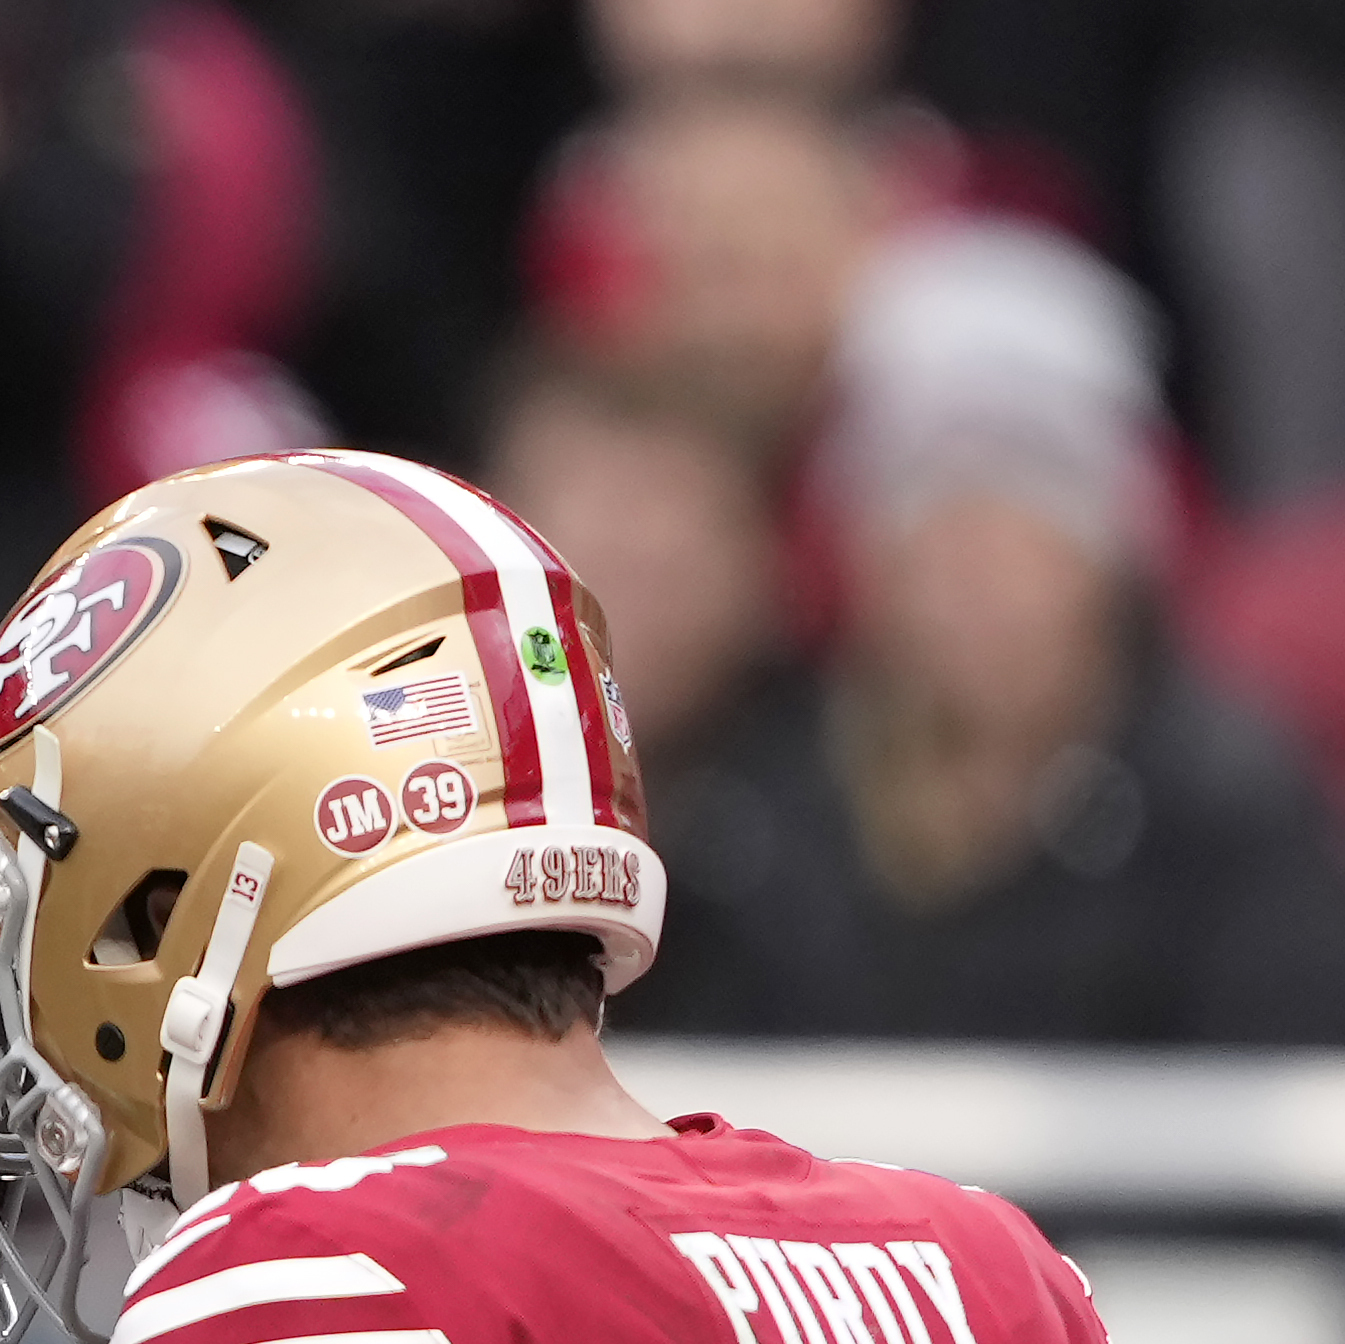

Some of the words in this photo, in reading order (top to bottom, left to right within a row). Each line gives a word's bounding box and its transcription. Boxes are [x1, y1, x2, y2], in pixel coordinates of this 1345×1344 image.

[326, 793, 387, 843] JM
[408, 771, 467, 825] 39
[232, 872, 258, 902] 13
[504, 844, 640, 907] 49ERS
